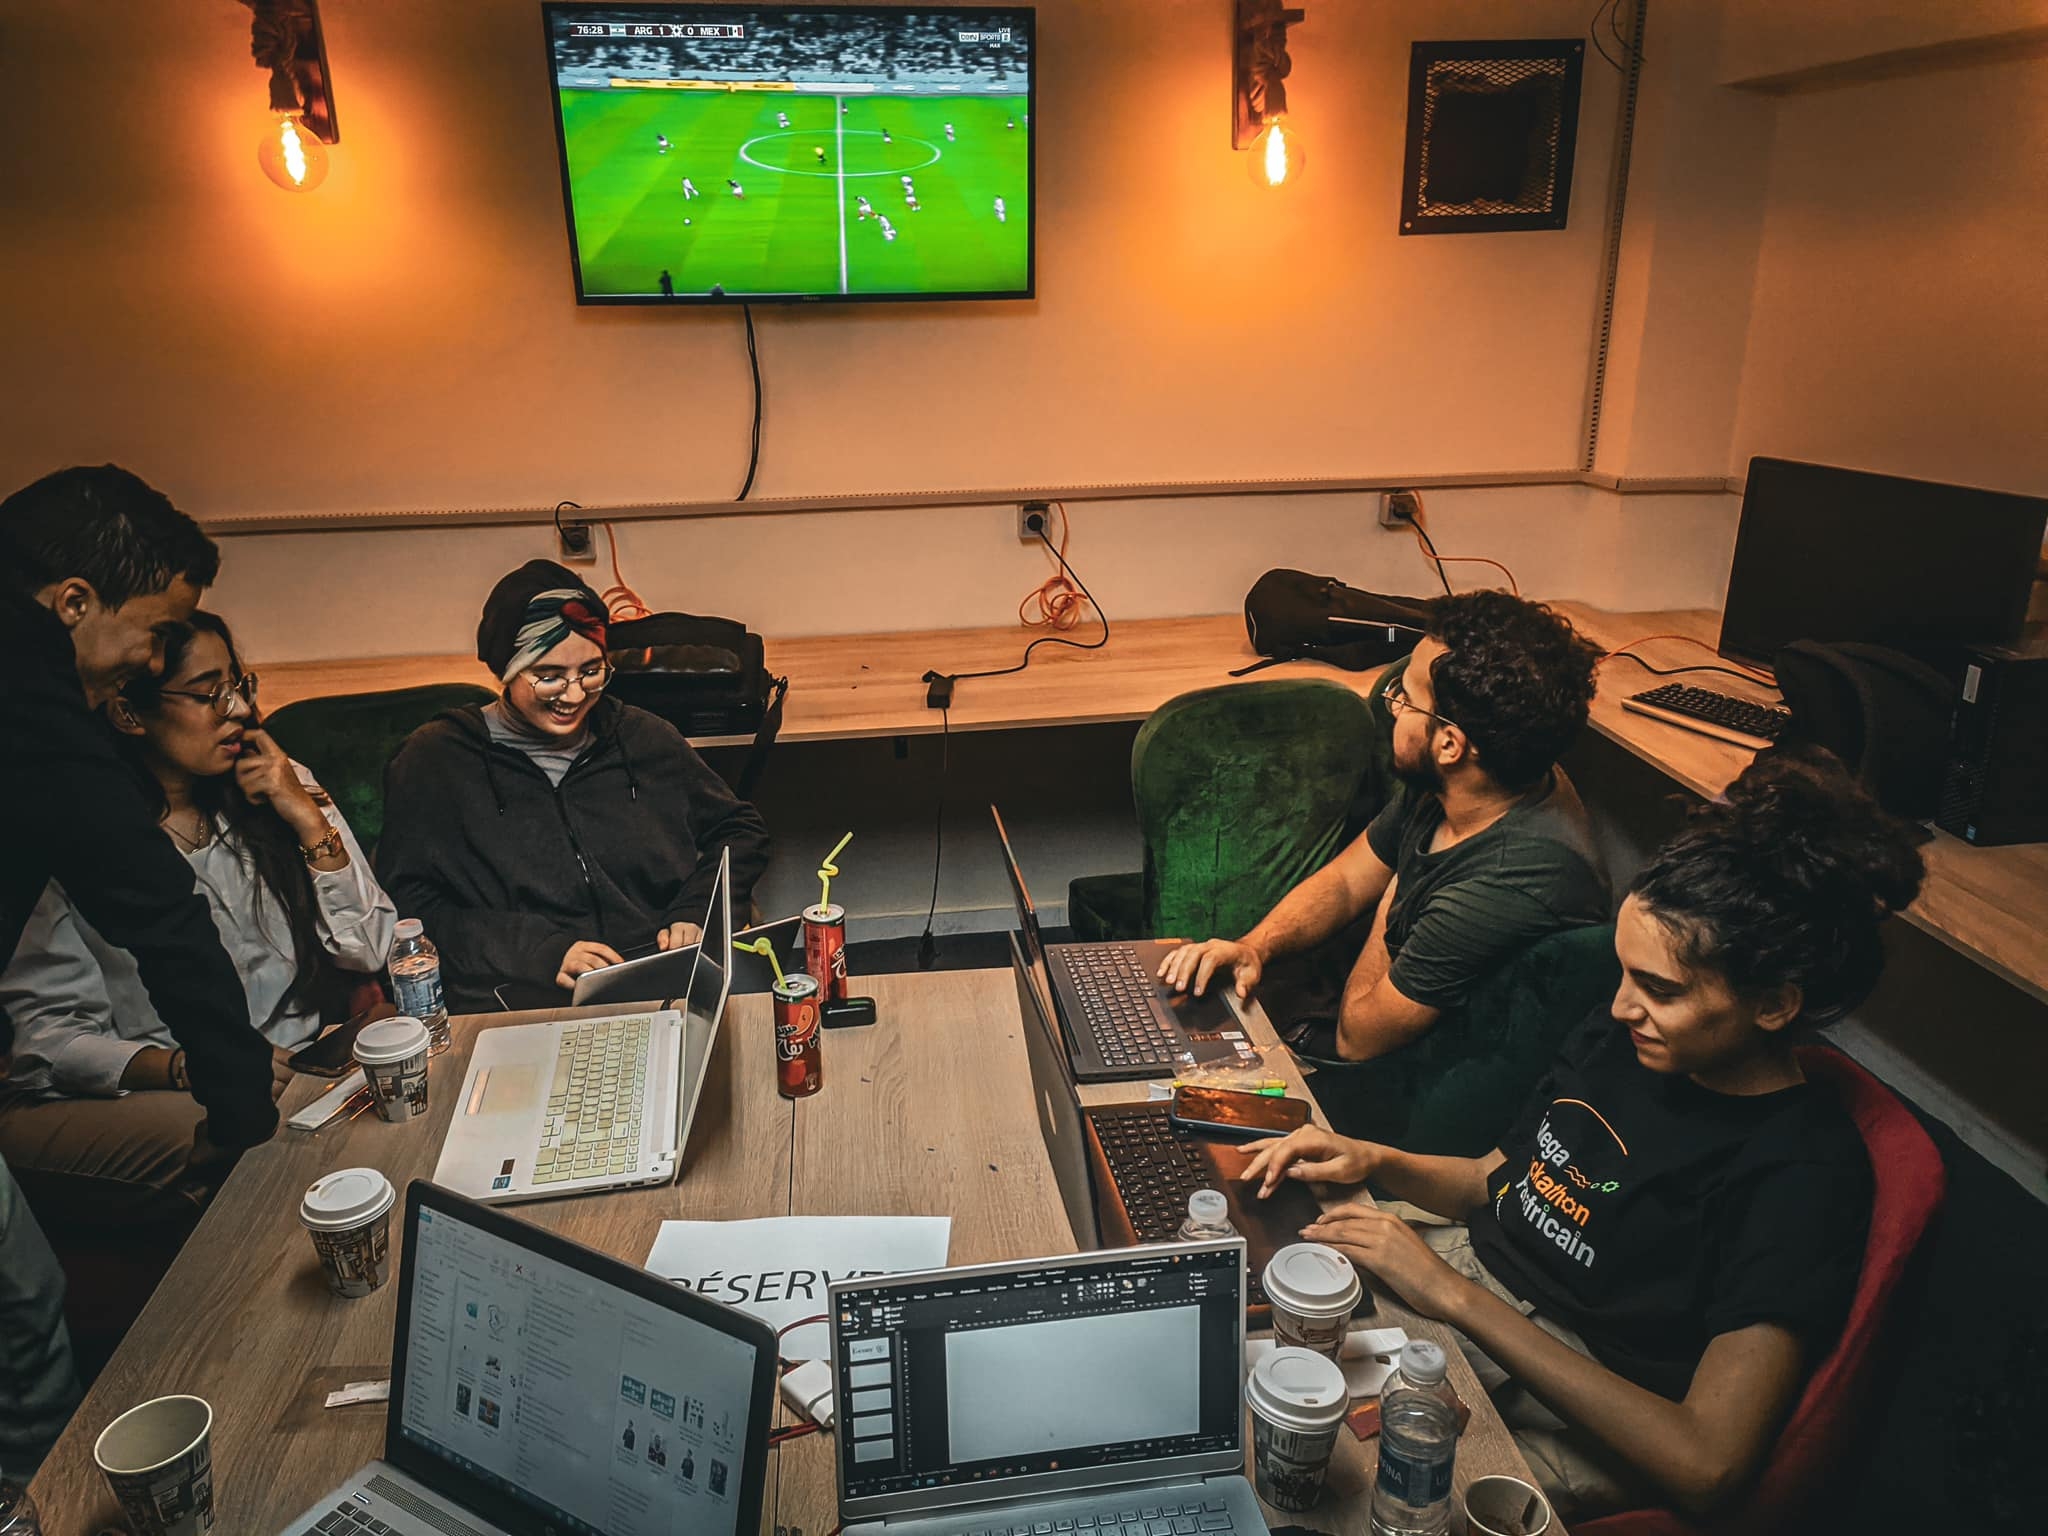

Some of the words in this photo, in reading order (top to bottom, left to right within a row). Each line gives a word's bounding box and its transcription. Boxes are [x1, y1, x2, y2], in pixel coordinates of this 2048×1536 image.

[576, 25, 604, 35] 76:28
[634, 26, 653, 35] ARG
[687, 27, 694, 36] 0
[700, 27, 720, 36] MEX
